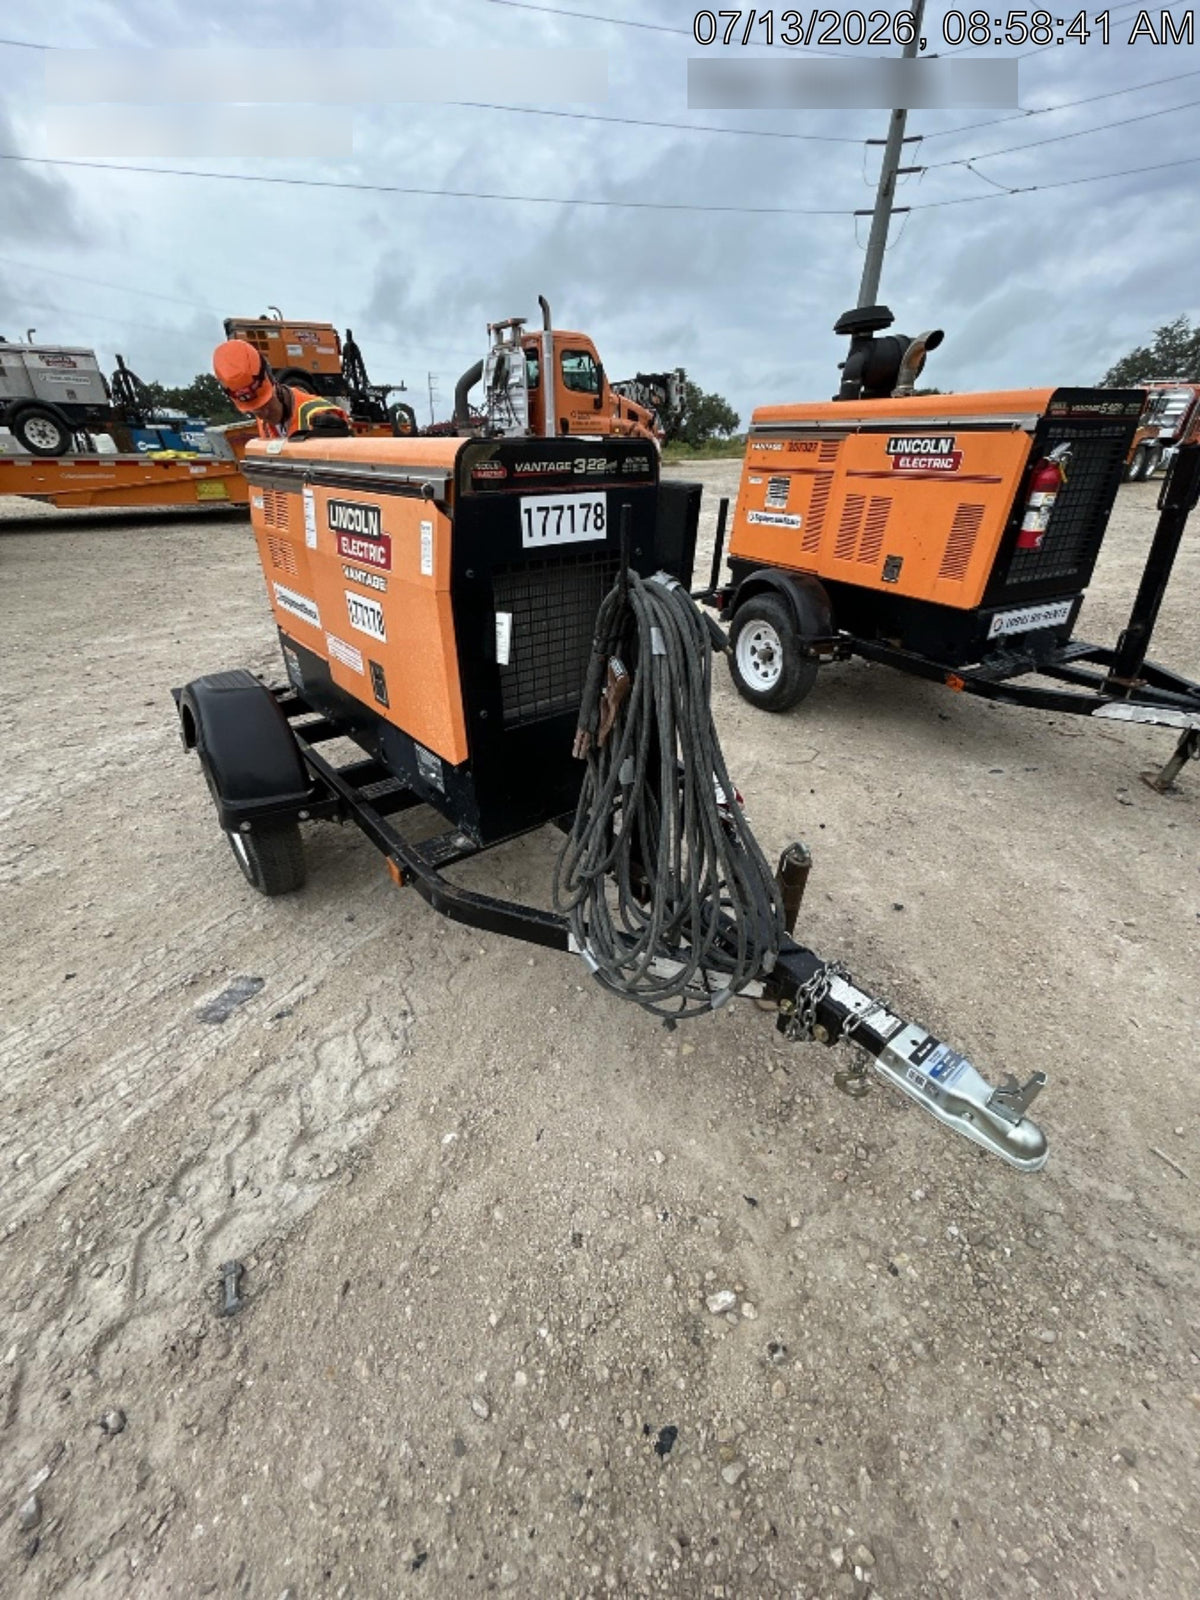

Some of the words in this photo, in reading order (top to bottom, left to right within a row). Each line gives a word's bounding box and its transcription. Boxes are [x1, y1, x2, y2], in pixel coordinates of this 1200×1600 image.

[889, 438, 951, 454] LINCOLN
[515, 460, 572, 473] VANTAGE
[899, 456, 954, 469] ELECTRIC
[329, 504, 379, 536] LINCOLN
[524, 502, 605, 538] 177178
[341, 536, 387, 565] ELECTRIC
